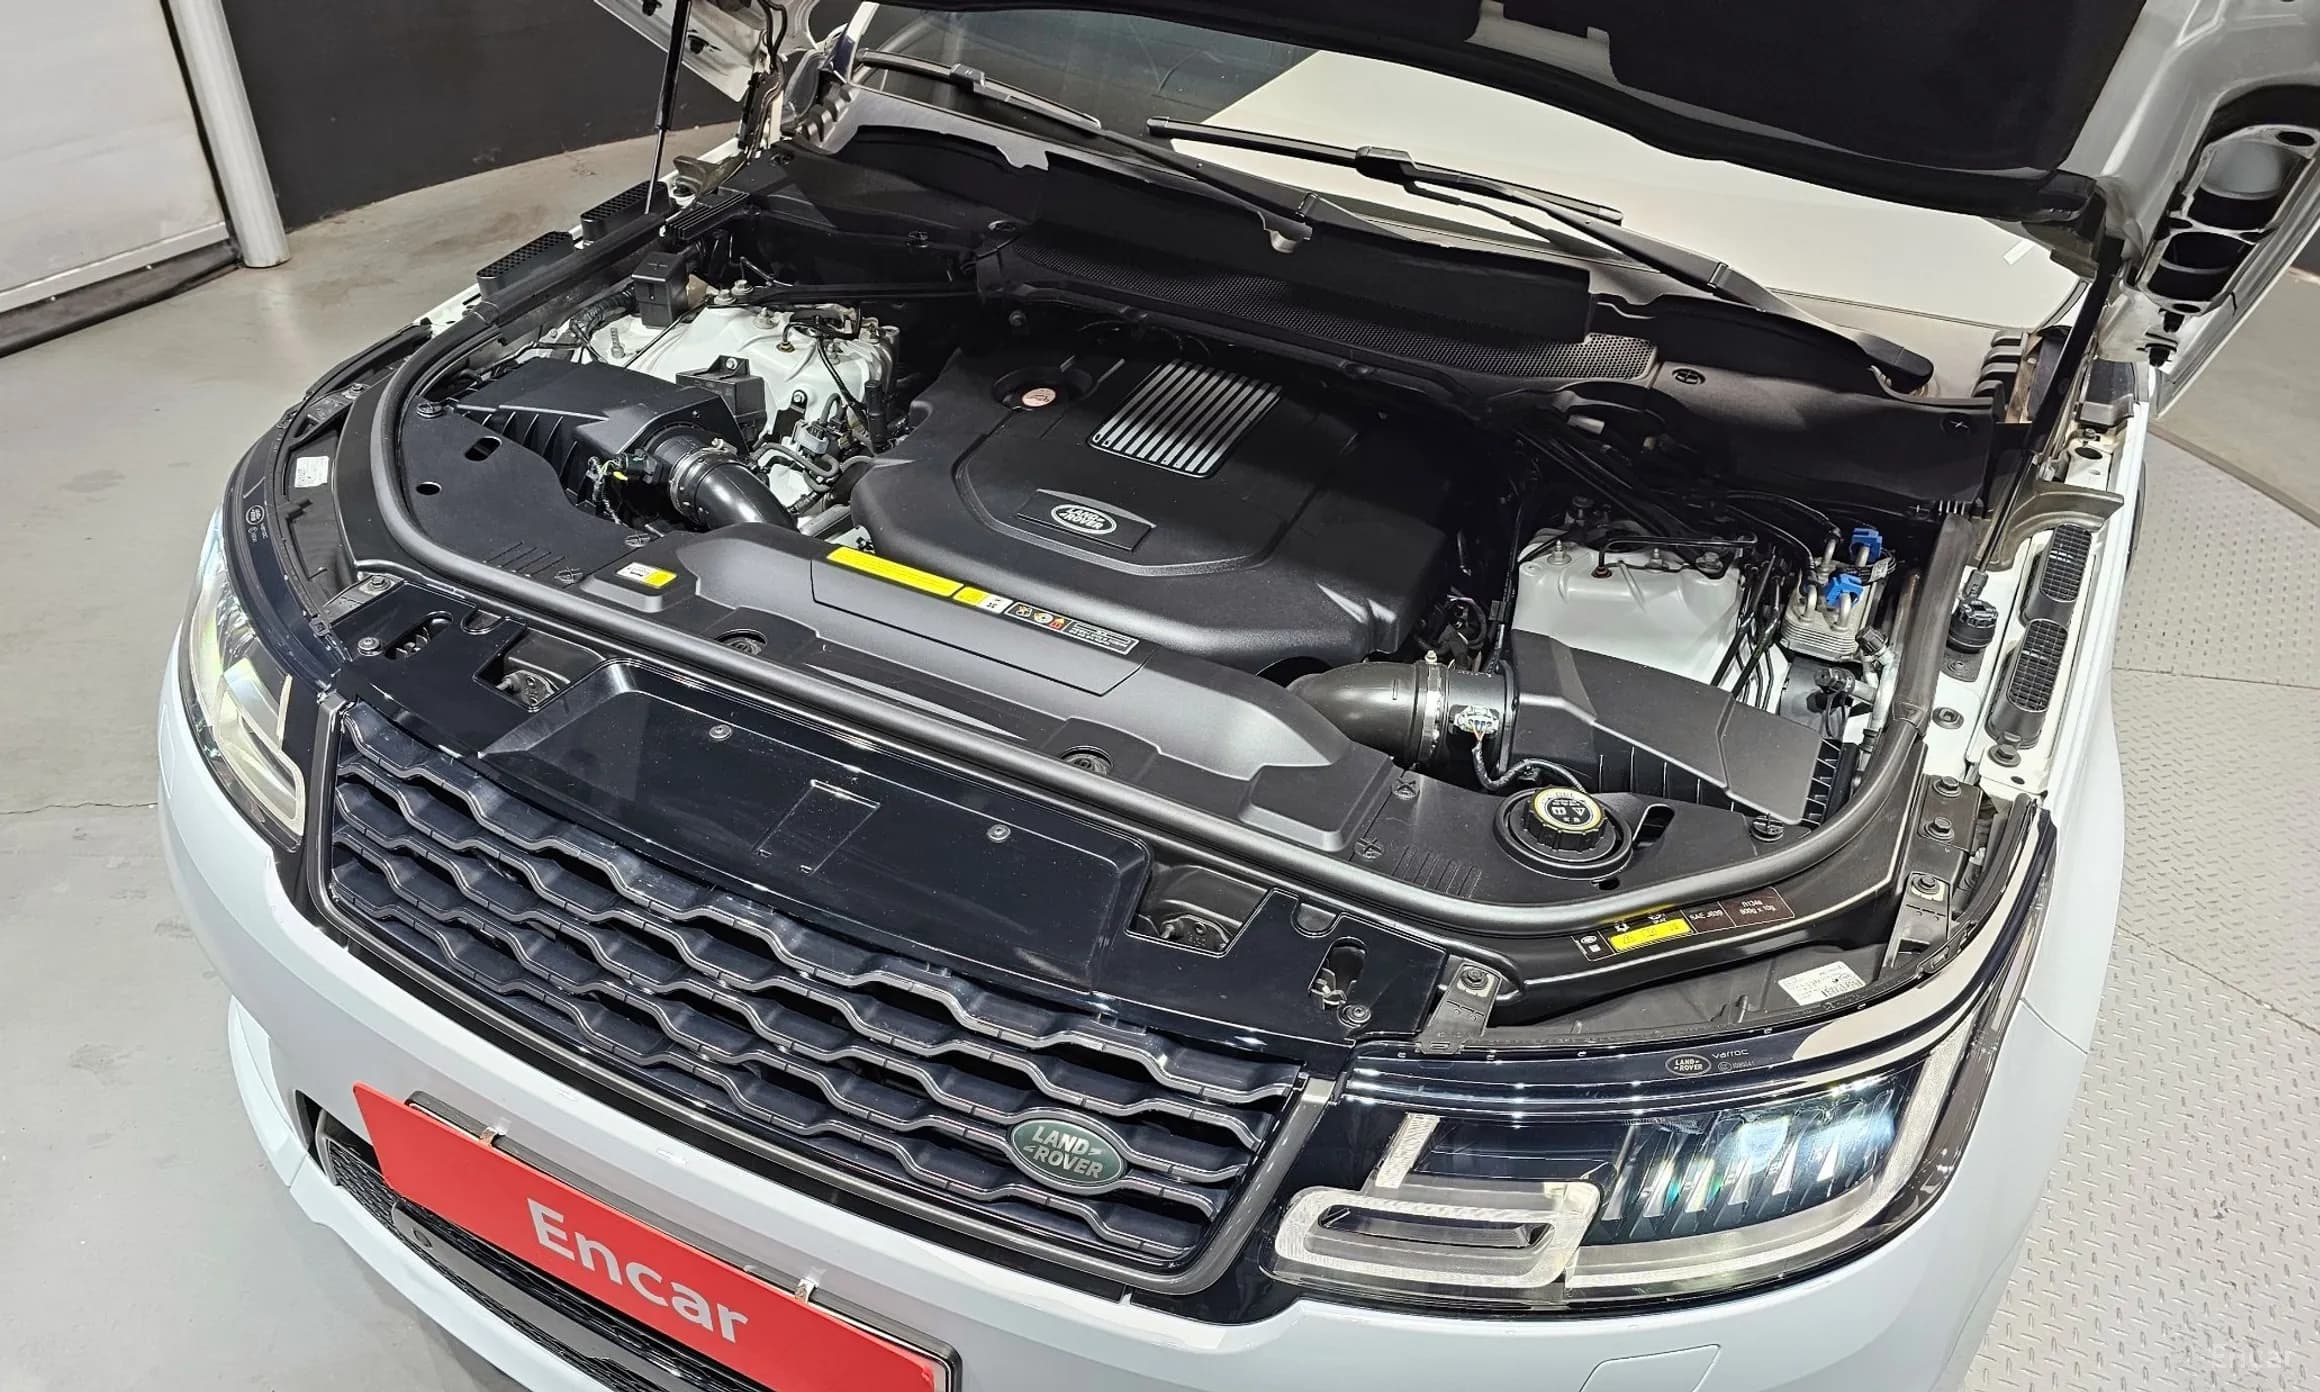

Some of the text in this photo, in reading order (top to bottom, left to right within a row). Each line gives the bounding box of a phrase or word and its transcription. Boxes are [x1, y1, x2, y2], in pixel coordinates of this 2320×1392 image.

[1063, 513, 1104, 530] ROVER
[1066, 508, 1100, 521] LAND
[1675, 1058, 1695, 1066] LAND
[1679, 1063, 1703, 1072] ROVER
[1032, 1125, 1090, 1156] LAND
[1032, 1144, 1104, 1179] ROVER
[527, 1197, 749, 1344] Encar
